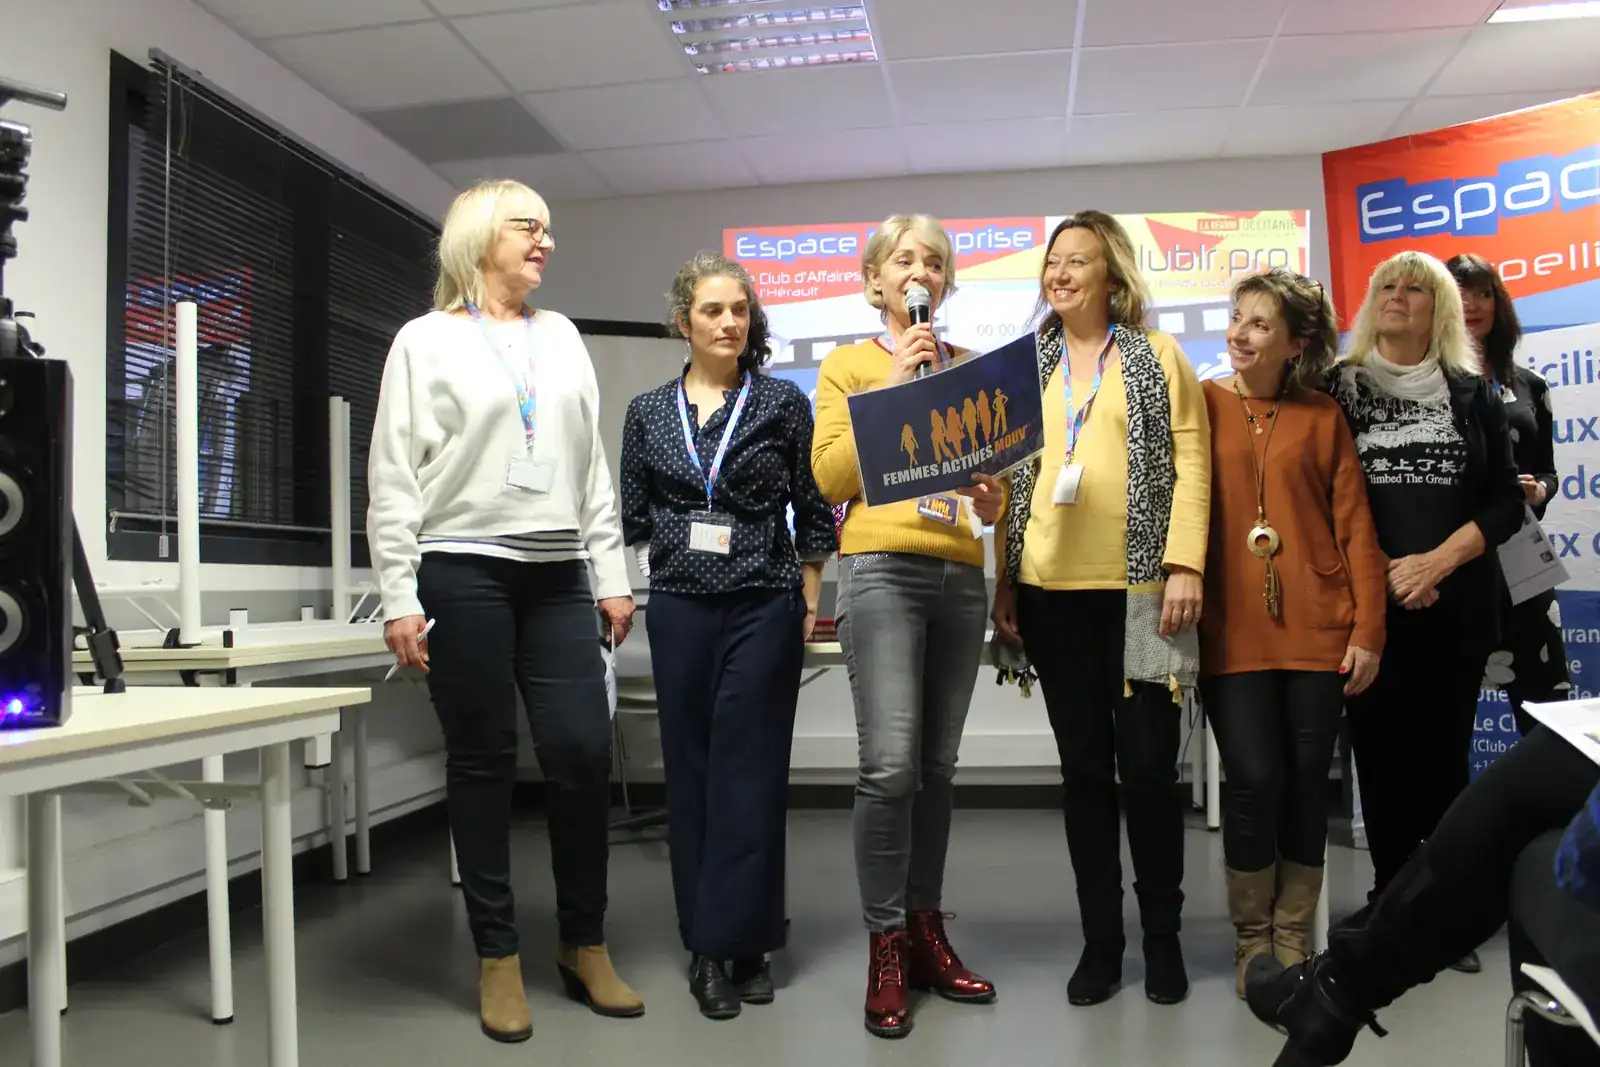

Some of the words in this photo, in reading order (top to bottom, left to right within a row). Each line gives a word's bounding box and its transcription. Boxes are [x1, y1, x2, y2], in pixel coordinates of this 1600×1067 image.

[1243, 218, 1297, 232] OCCITANIE
[736, 236, 858, 260] Espace
[948, 228, 1033, 255] prise
[760, 271, 791, 286] Club
[883, 463, 940, 487] FEMMES
[942, 444, 993, 475] ACTIVES
[1367, 473, 1402, 485] limbed
[1404, 473, 1424, 484] The
[1425, 473, 1452, 486] Great
